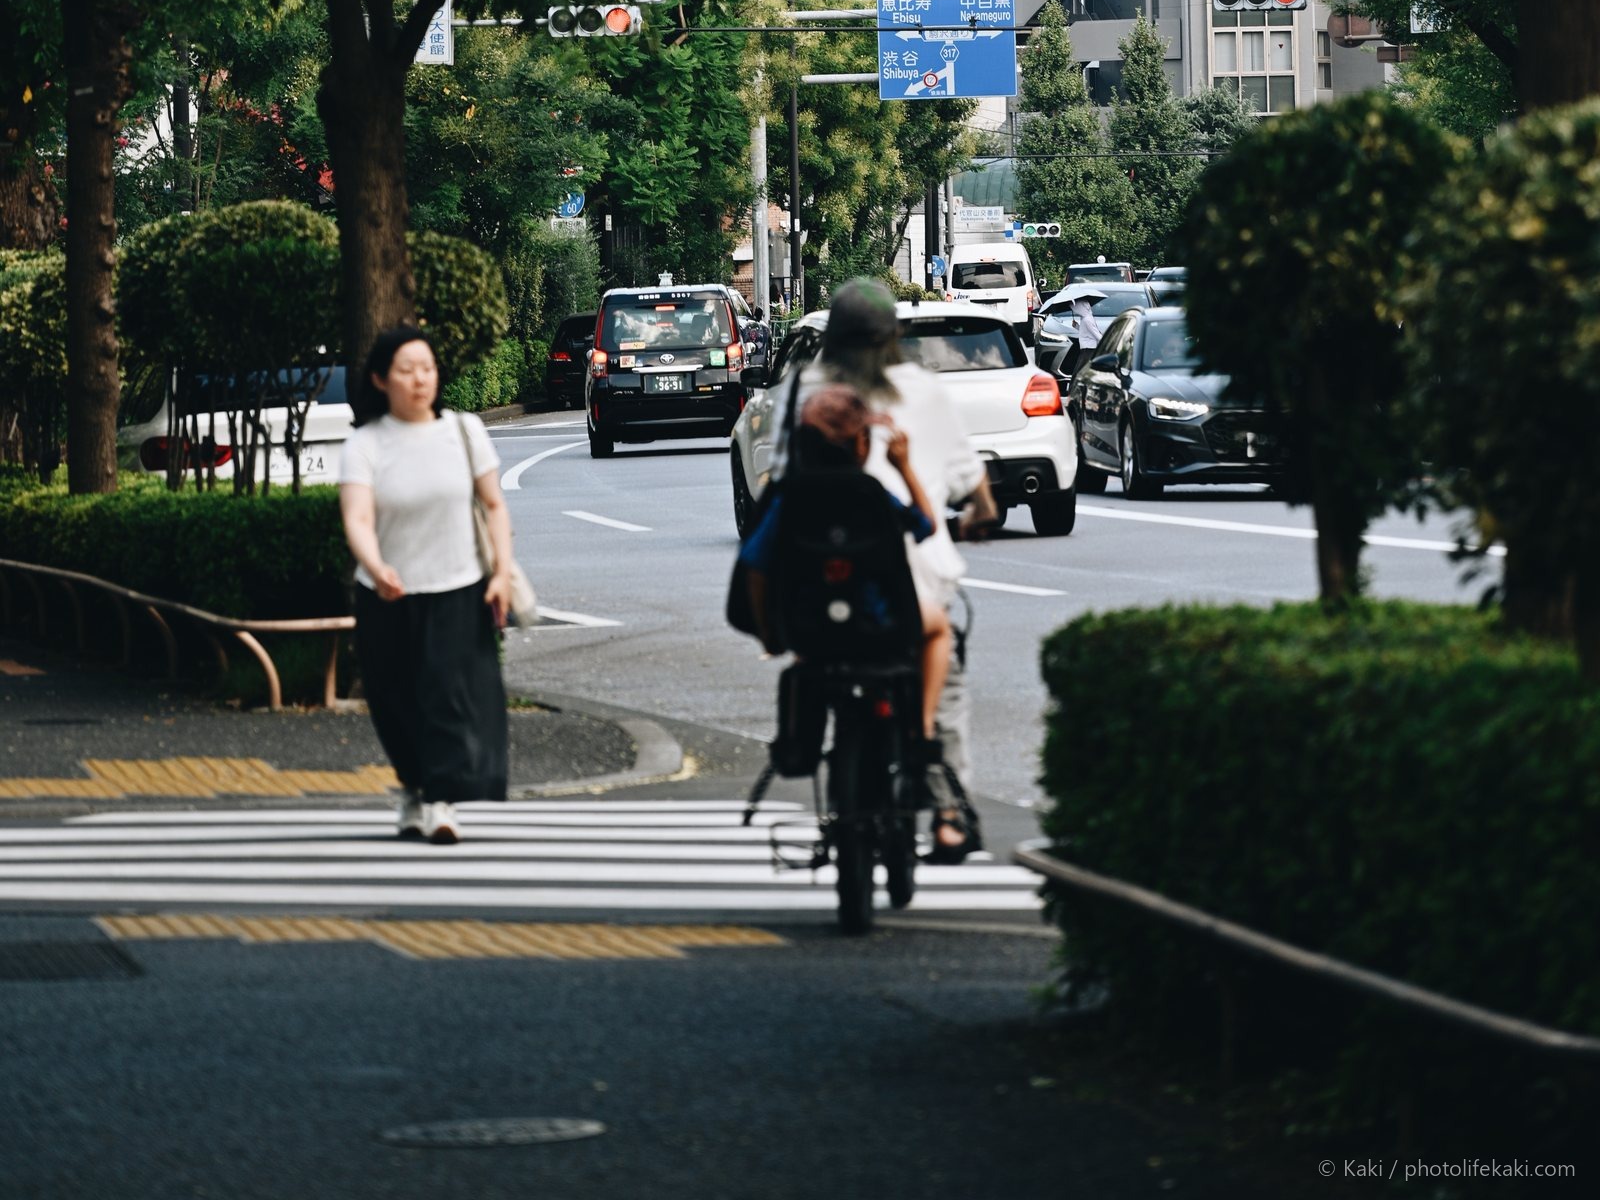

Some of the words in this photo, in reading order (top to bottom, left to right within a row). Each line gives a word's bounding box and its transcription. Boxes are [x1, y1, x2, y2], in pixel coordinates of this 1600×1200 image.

[892, 12, 921, 24] Ebisu
[960, 10, 1011, 23] Nakameguro
[883, 51, 919, 67] 渋谷
[943, 49, 957, 58] 317
[883, 68, 919, 81] Shibuya
[566, 202, 577, 214] 60
